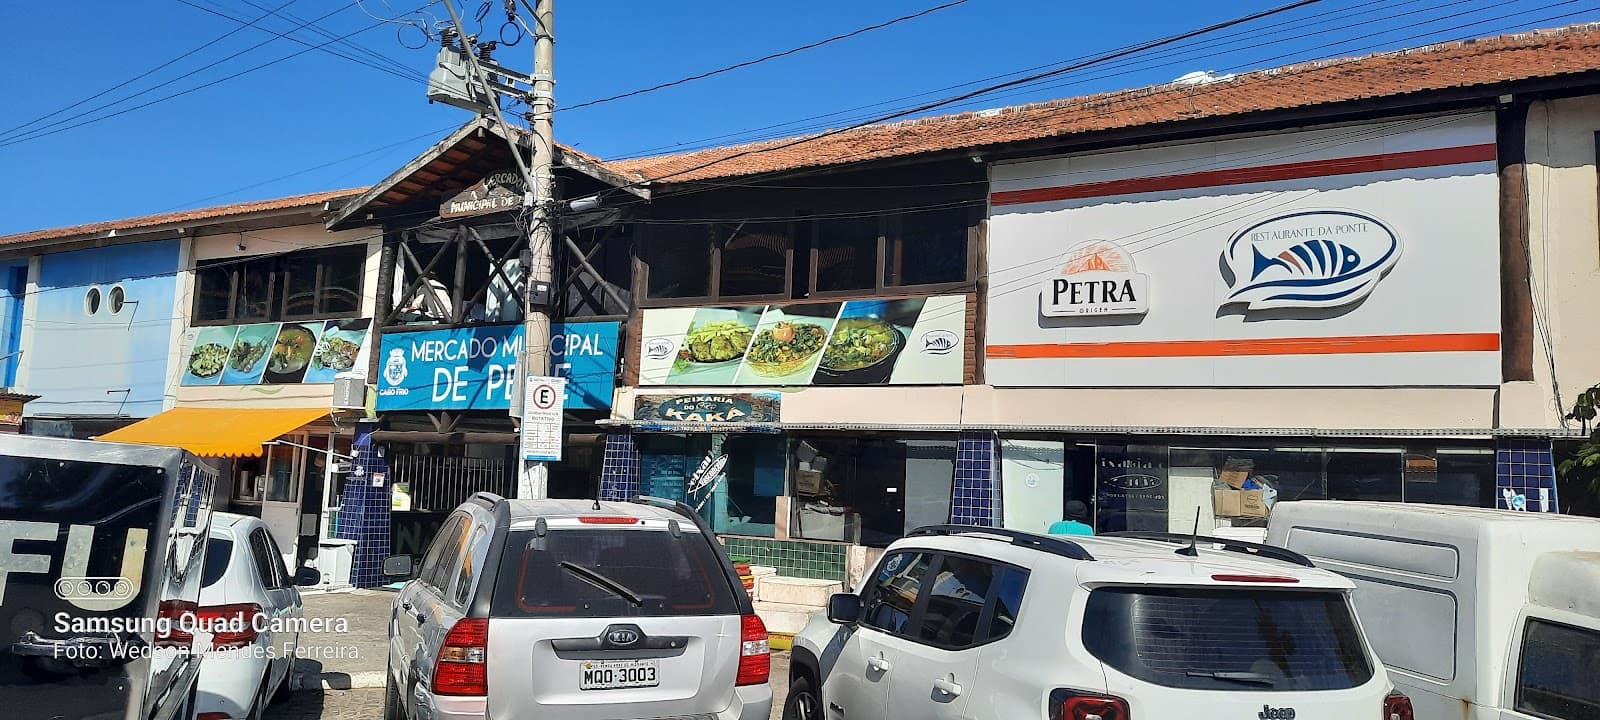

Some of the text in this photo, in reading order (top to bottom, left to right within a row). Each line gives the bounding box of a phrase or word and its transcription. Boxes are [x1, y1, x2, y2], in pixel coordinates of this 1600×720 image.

[450, 197, 498, 213] MUNICIPAL
[501, 196, 514, 207] DE
[1251, 223, 1368, 241] RESTAURANTE DA PONTE
[1052, 278, 1137, 305] PETRA
[411, 333, 604, 362] MERCADO MCIPAL
[432, 362, 572, 402] DE PEE
[540, 389, 549, 404] E
[675, 396, 734, 404] PEIXARIA
[613, 632, 634, 642] KIA
[1257, 704, 1296, 720] Jeep
